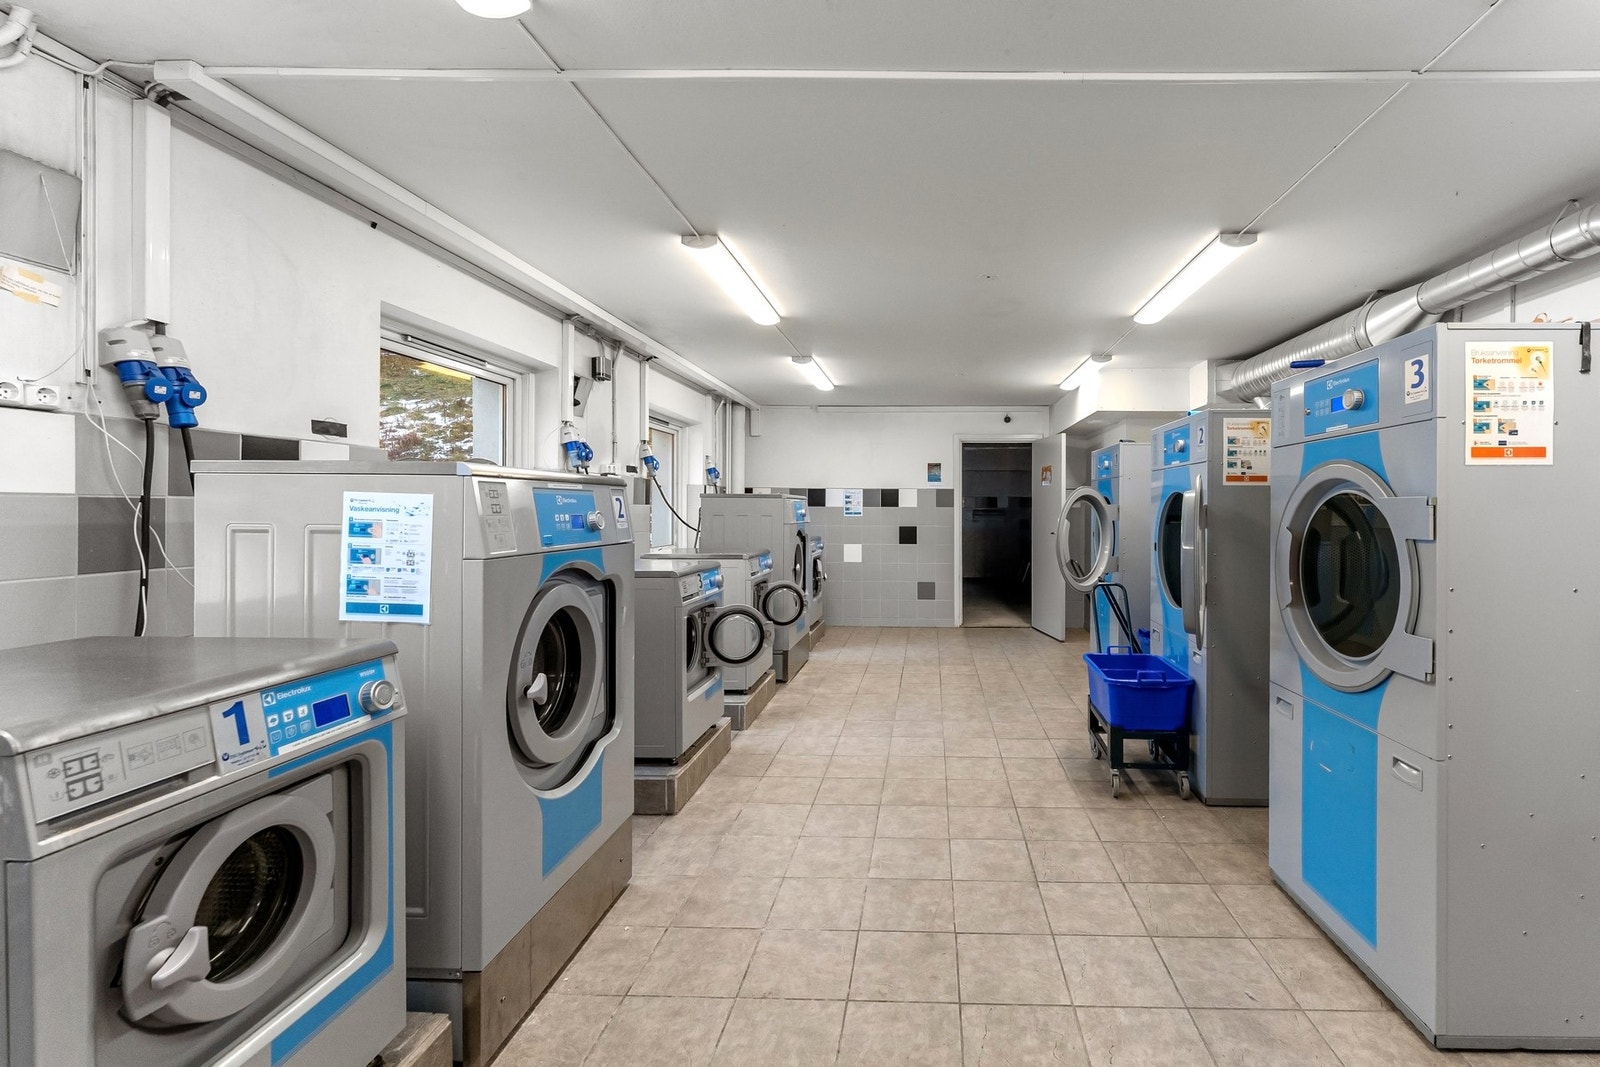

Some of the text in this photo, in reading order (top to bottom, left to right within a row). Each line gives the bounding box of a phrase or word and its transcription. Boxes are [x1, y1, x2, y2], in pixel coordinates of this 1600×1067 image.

[1411, 359, 1425, 389] 3
[1199, 428, 1204, 444] 2
[349, 505, 400, 514] Vaskeanvisning
[615, 497, 625, 518] 2
[697, 573, 703, 588] 3
[276, 685, 313, 700] Electrolux
[222, 700, 250, 746] 1
